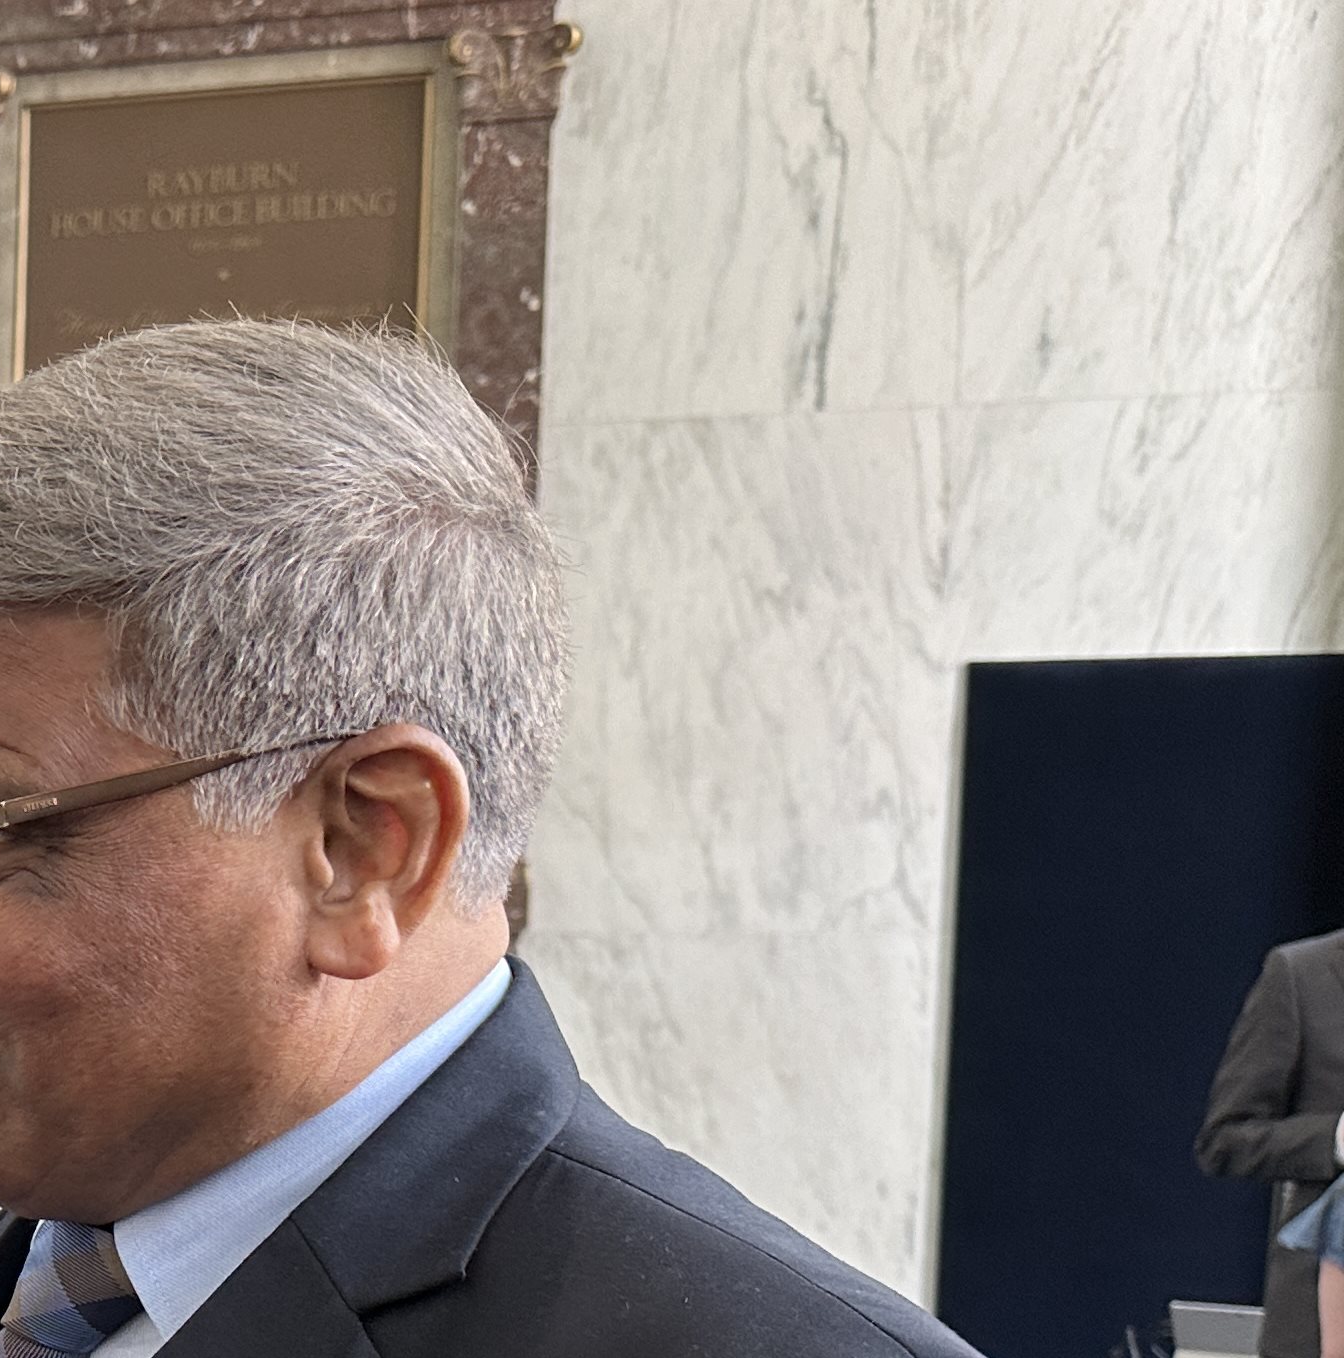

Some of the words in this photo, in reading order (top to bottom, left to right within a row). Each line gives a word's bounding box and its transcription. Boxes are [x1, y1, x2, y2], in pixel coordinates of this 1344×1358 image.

[147, 161, 300, 197] RAYBURN
[50, 206, 148, 239] HOUSE
[150, 197, 250, 231] OFFICE
[255, 188, 397, 224] BUILDING
